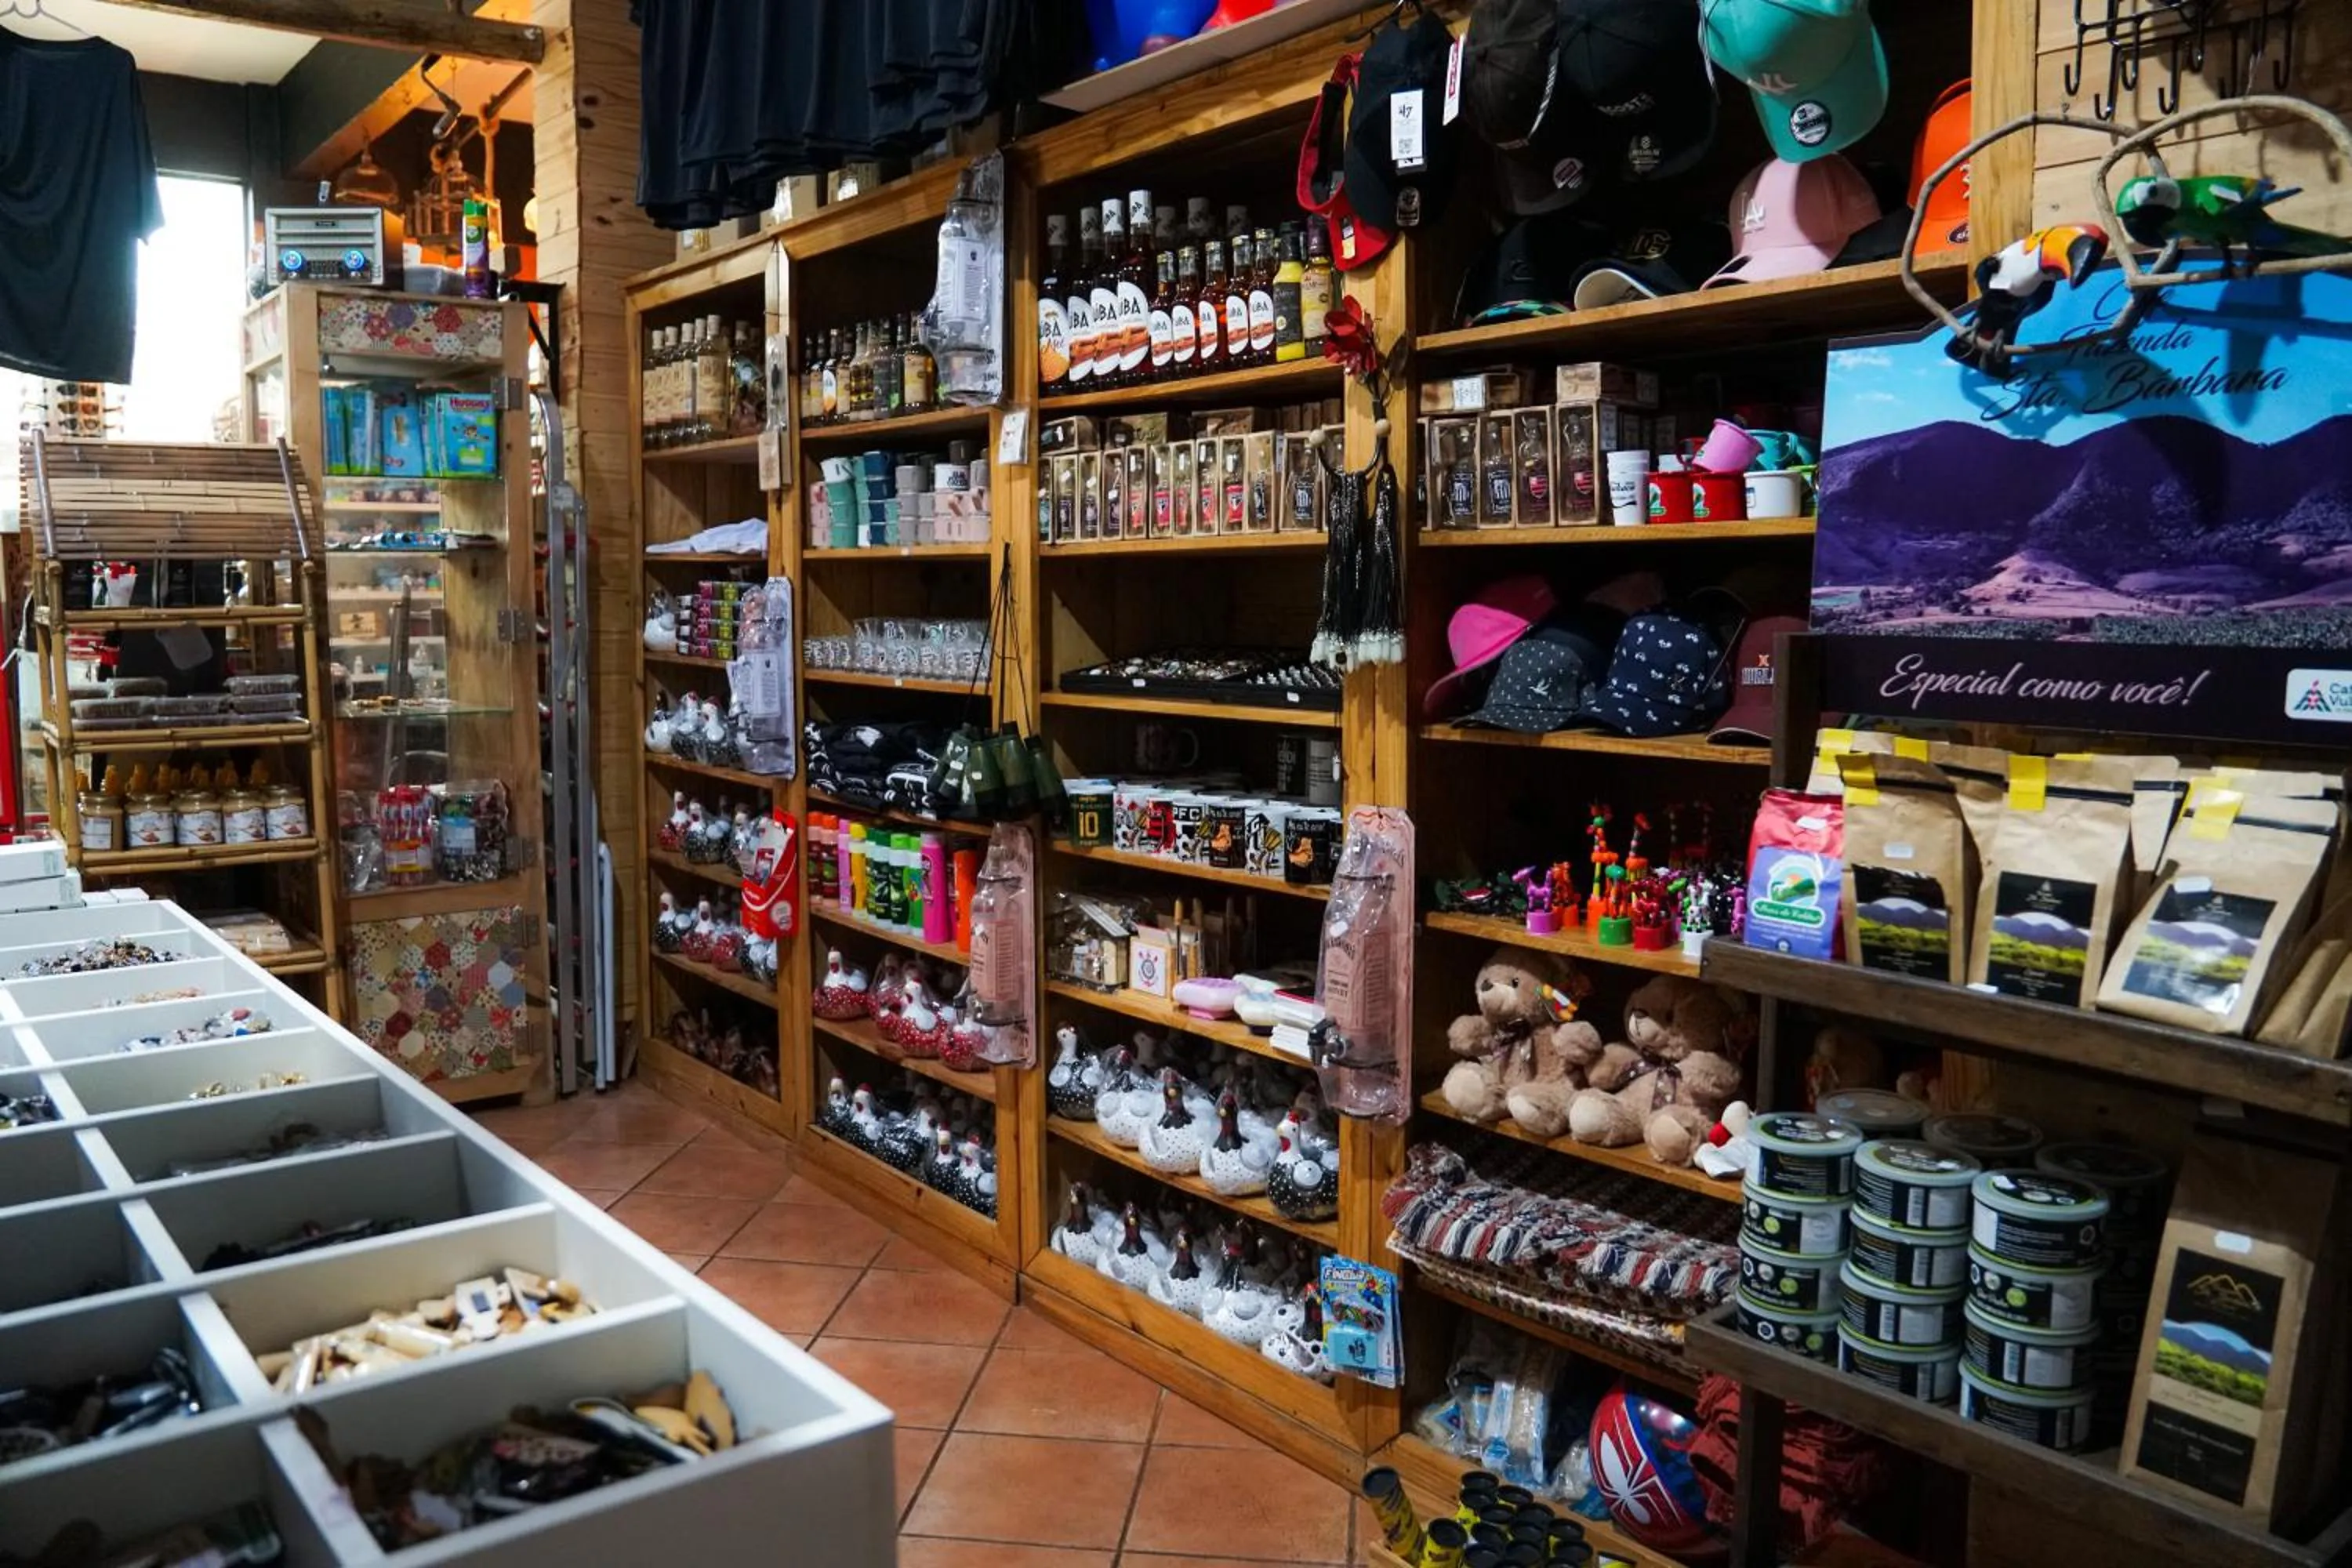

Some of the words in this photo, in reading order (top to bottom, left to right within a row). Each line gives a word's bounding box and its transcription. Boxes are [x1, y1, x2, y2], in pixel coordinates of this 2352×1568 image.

[2083, 356, 2290, 415] Bárbara
[1879, 653, 2024, 710] Especial
[2018, 676, 2107, 702] como
[2110, 669, 2211, 706] você!
[1079, 811, 1099, 838] 10
